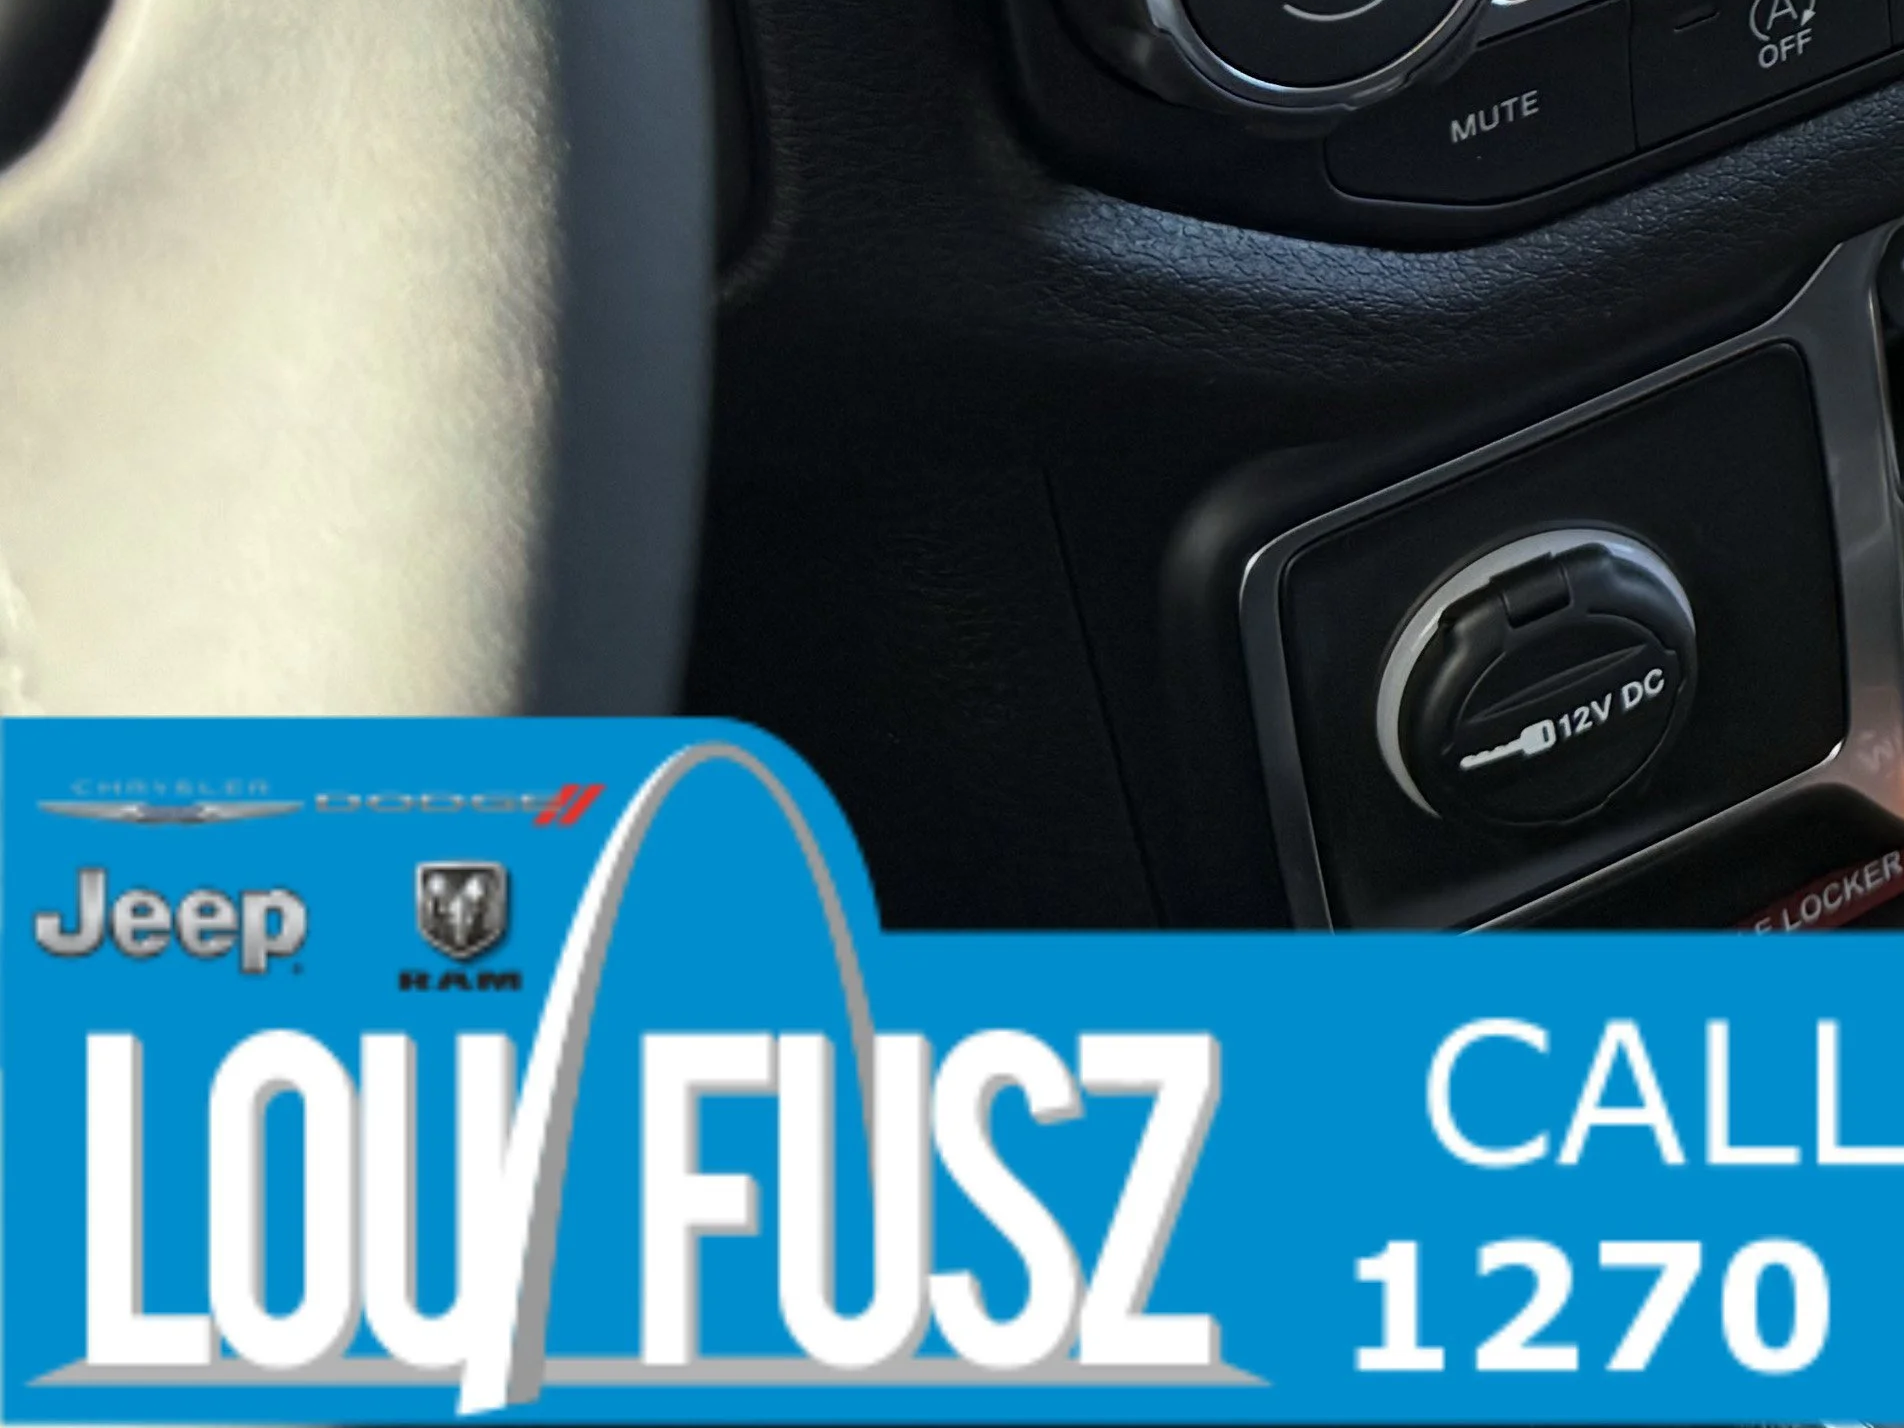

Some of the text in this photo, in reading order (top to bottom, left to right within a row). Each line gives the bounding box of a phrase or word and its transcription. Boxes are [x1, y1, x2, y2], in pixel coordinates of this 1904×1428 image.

[1757, 28, 1815, 71] OFF
[1449, 90, 1541, 145] MUTE
[1556, 666, 1667, 741] 12V DC
[1783, 850, 1904, 932] LOCKER
